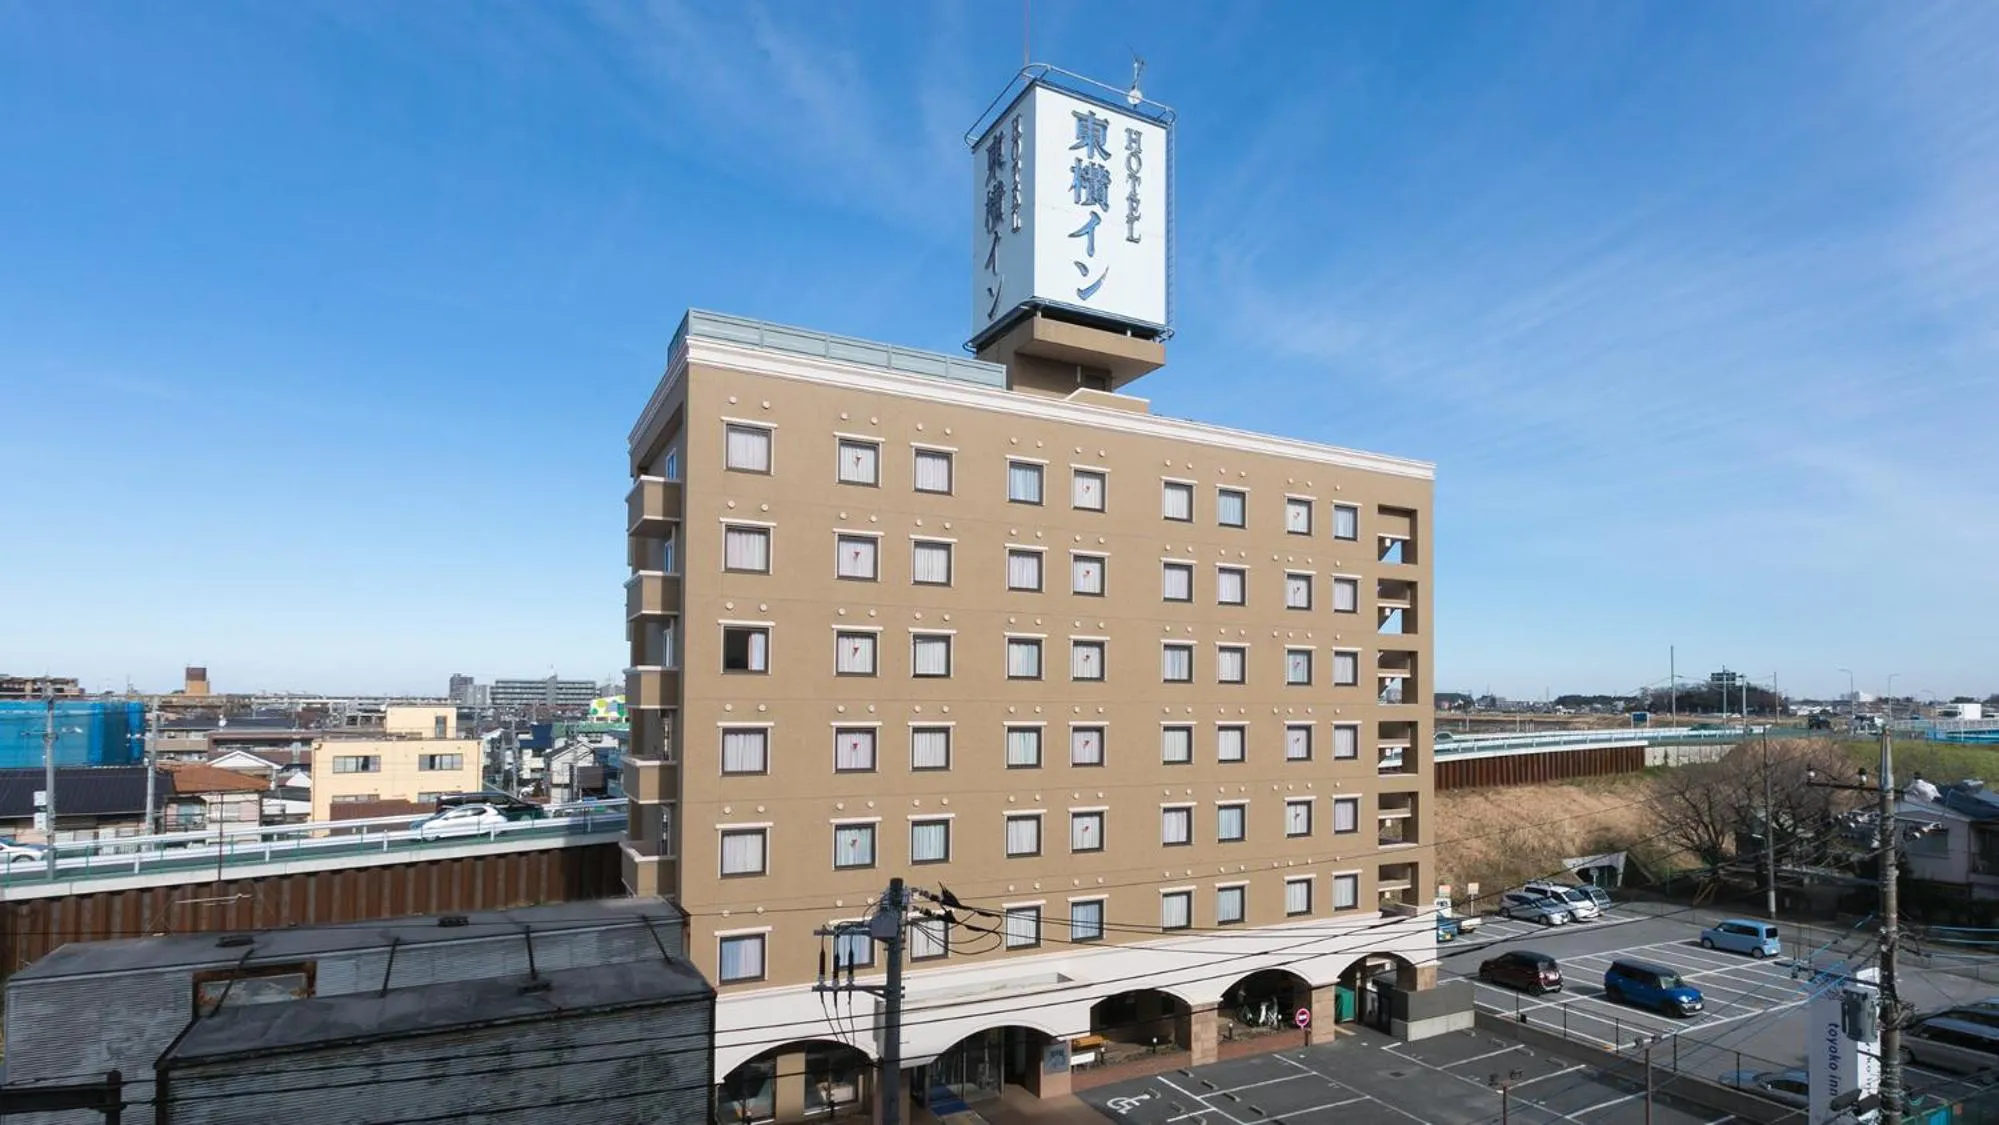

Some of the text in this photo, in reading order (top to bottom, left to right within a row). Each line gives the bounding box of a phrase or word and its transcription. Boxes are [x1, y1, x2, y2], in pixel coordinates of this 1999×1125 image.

[1068, 110, 1111, 300] 東横イン
[1125, 127, 1142, 243] HOTEL
[1826, 1022, 1841, 1096] toyoko inn
